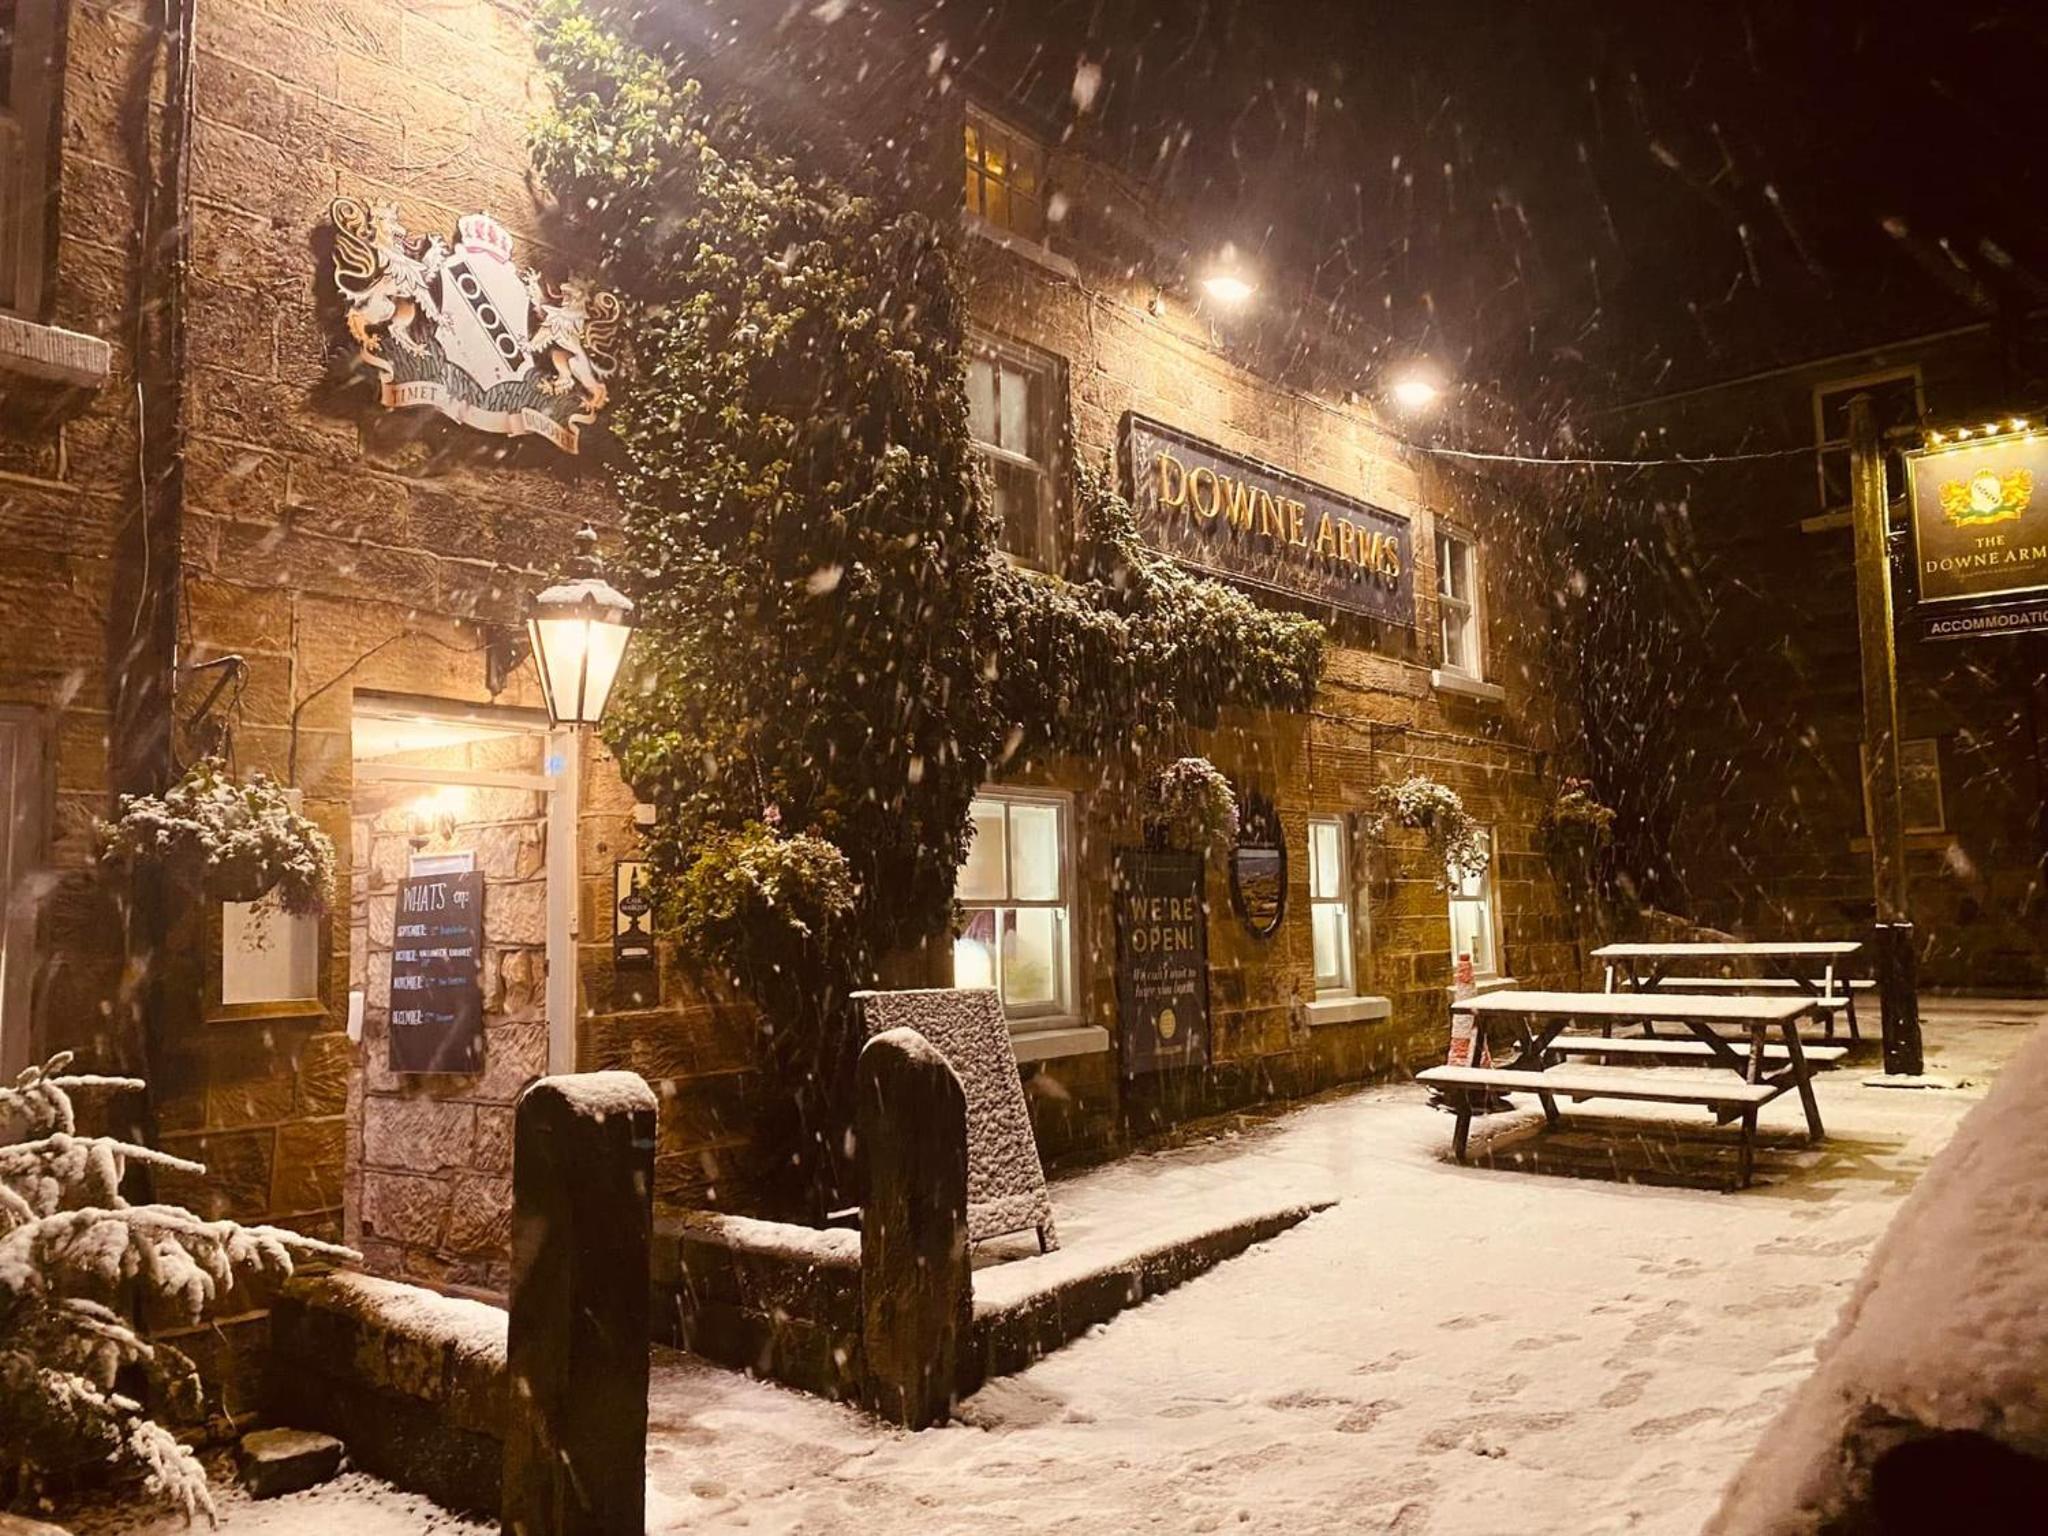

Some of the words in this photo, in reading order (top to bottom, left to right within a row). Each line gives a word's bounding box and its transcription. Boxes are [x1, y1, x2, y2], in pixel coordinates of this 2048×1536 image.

[391, 386, 438, 404] TIMET
[1157, 452, 1307, 547] DOWNE
[1315, 511, 1400, 577] ARMS
[1975, 535, 2005, 548] THE
[1926, 552, 1999, 573] DOWNE
[2004, 545, 2048, 563] ARM
[1131, 896, 1193, 921] WE'RE
[1132, 926, 1194, 952] OPEN!
